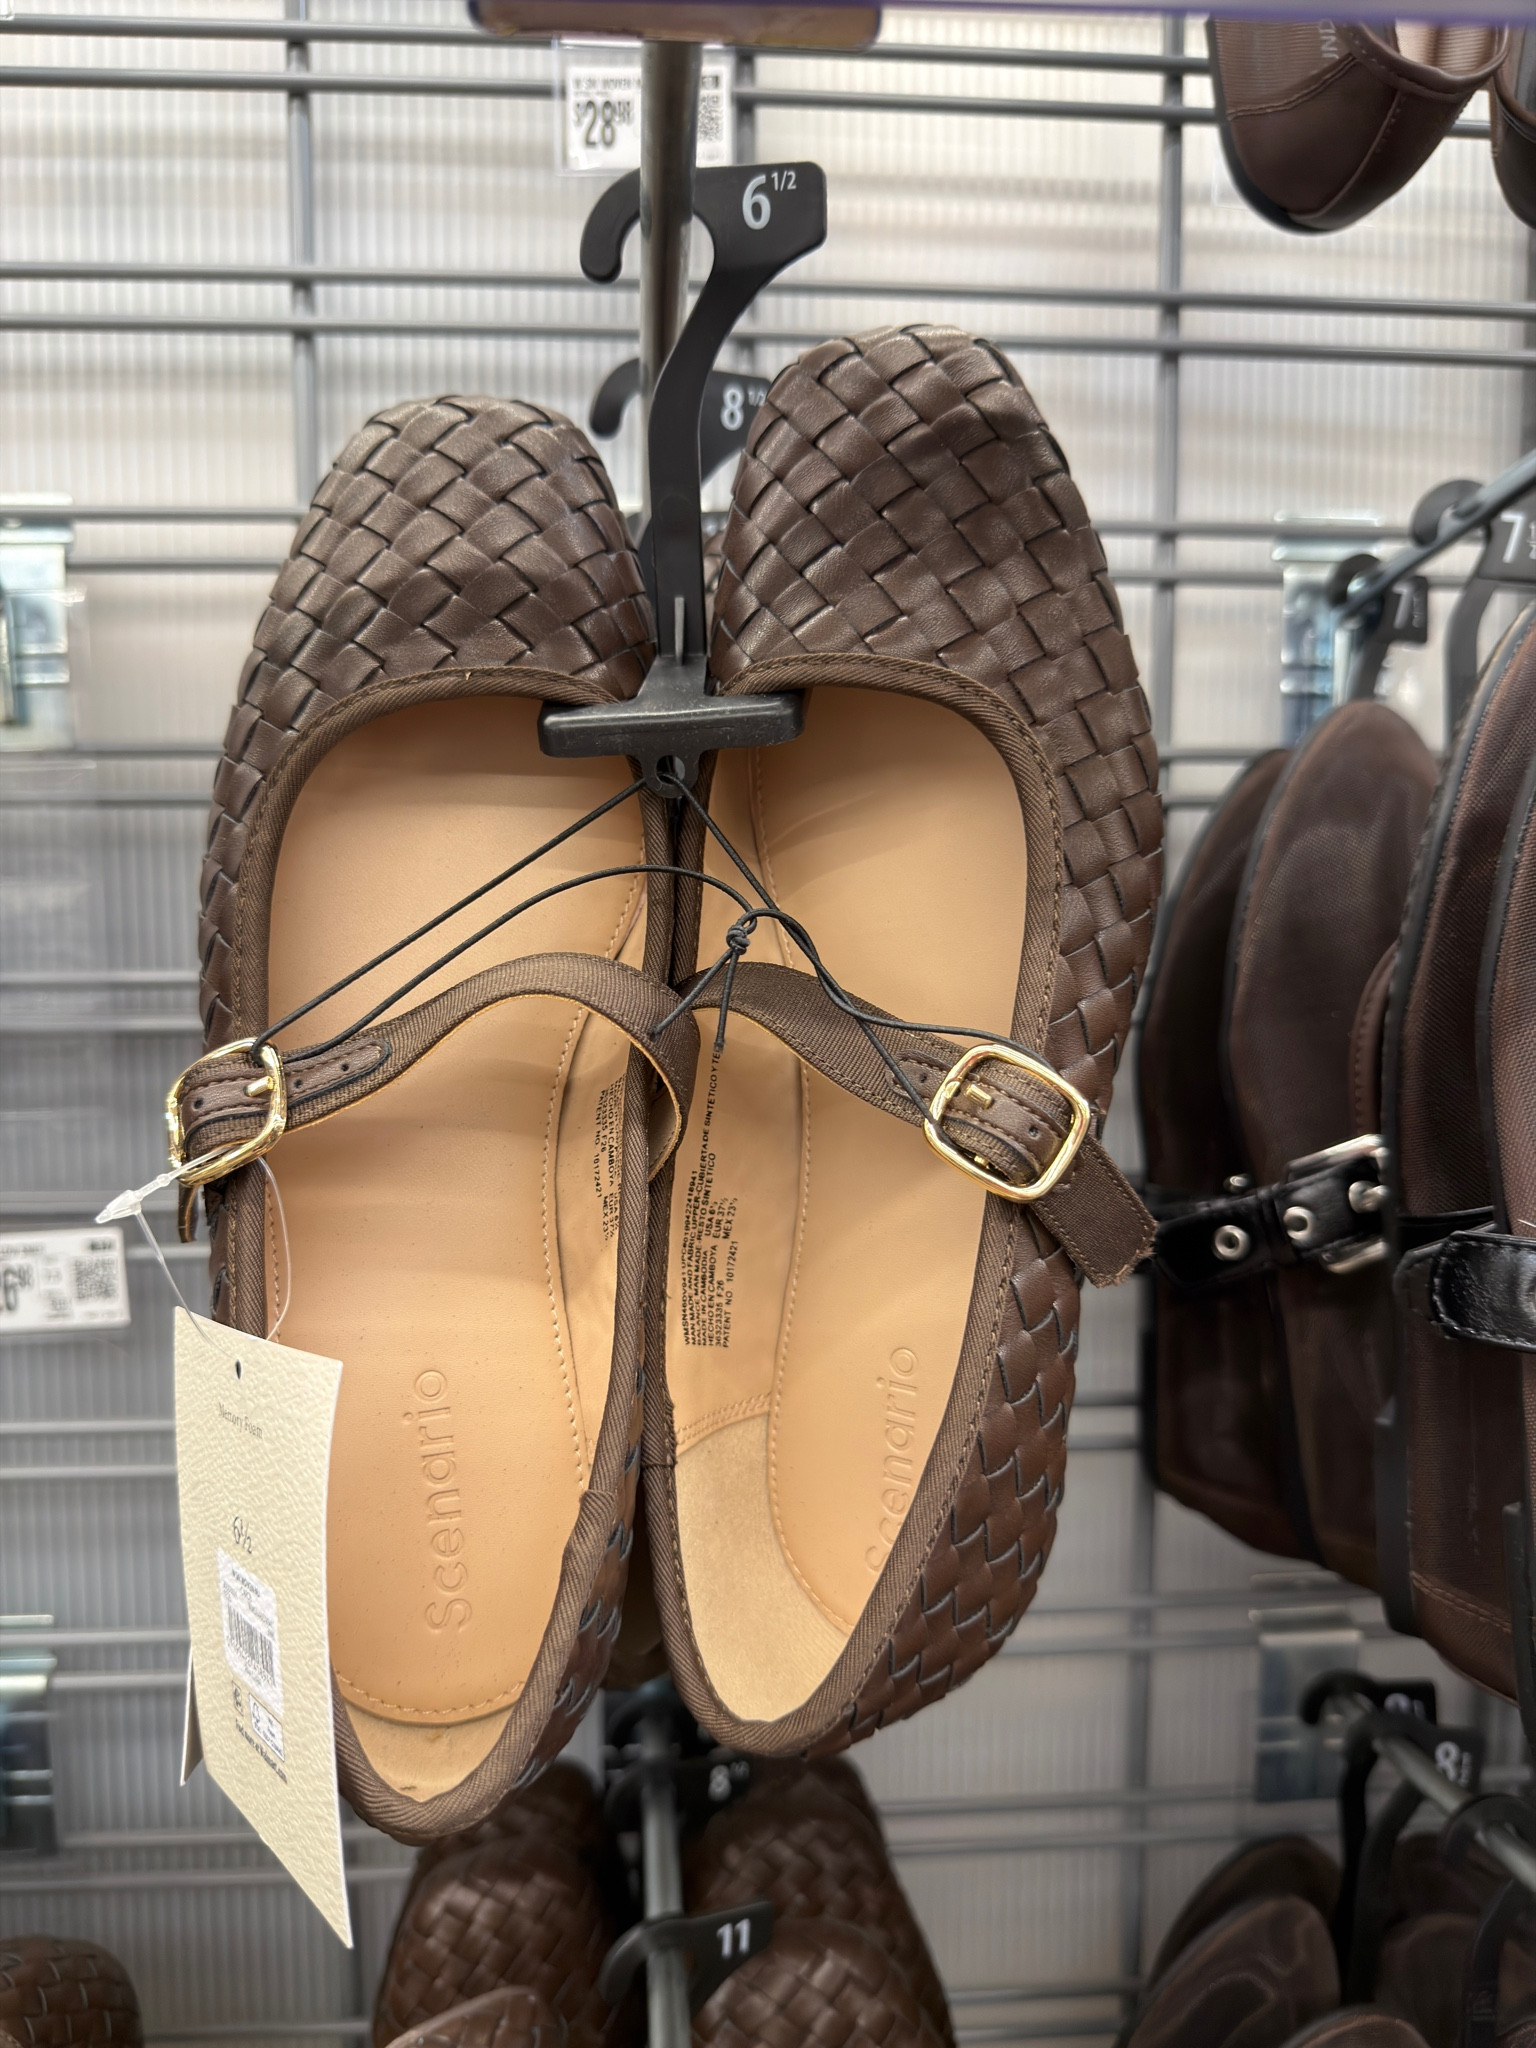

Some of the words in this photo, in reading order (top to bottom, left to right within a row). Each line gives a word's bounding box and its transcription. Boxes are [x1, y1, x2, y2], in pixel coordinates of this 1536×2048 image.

[702, 1153, 716, 1205] SINTETICO
[704, 1217, 714, 1236] USA
[713, 1219, 723, 1238] EUR
[722, 1218, 733, 1239] MEX
[687, 1231, 696, 1267] FABRIC
[726, 1241, 738, 1282] 10172421
[700, 1250, 708, 1302] CAMBODIA
[708, 1245, 717, 1292] CAMBOYA
[708, 1295, 715, 1308] EN
[716, 1280, 724, 1297] F26
[701, 1304, 706, 1314] IN
[723, 1310, 731, 1348] PATENT
[402, 1370, 473, 1633] Scenario
[717, 1918, 751, 1959] 11
